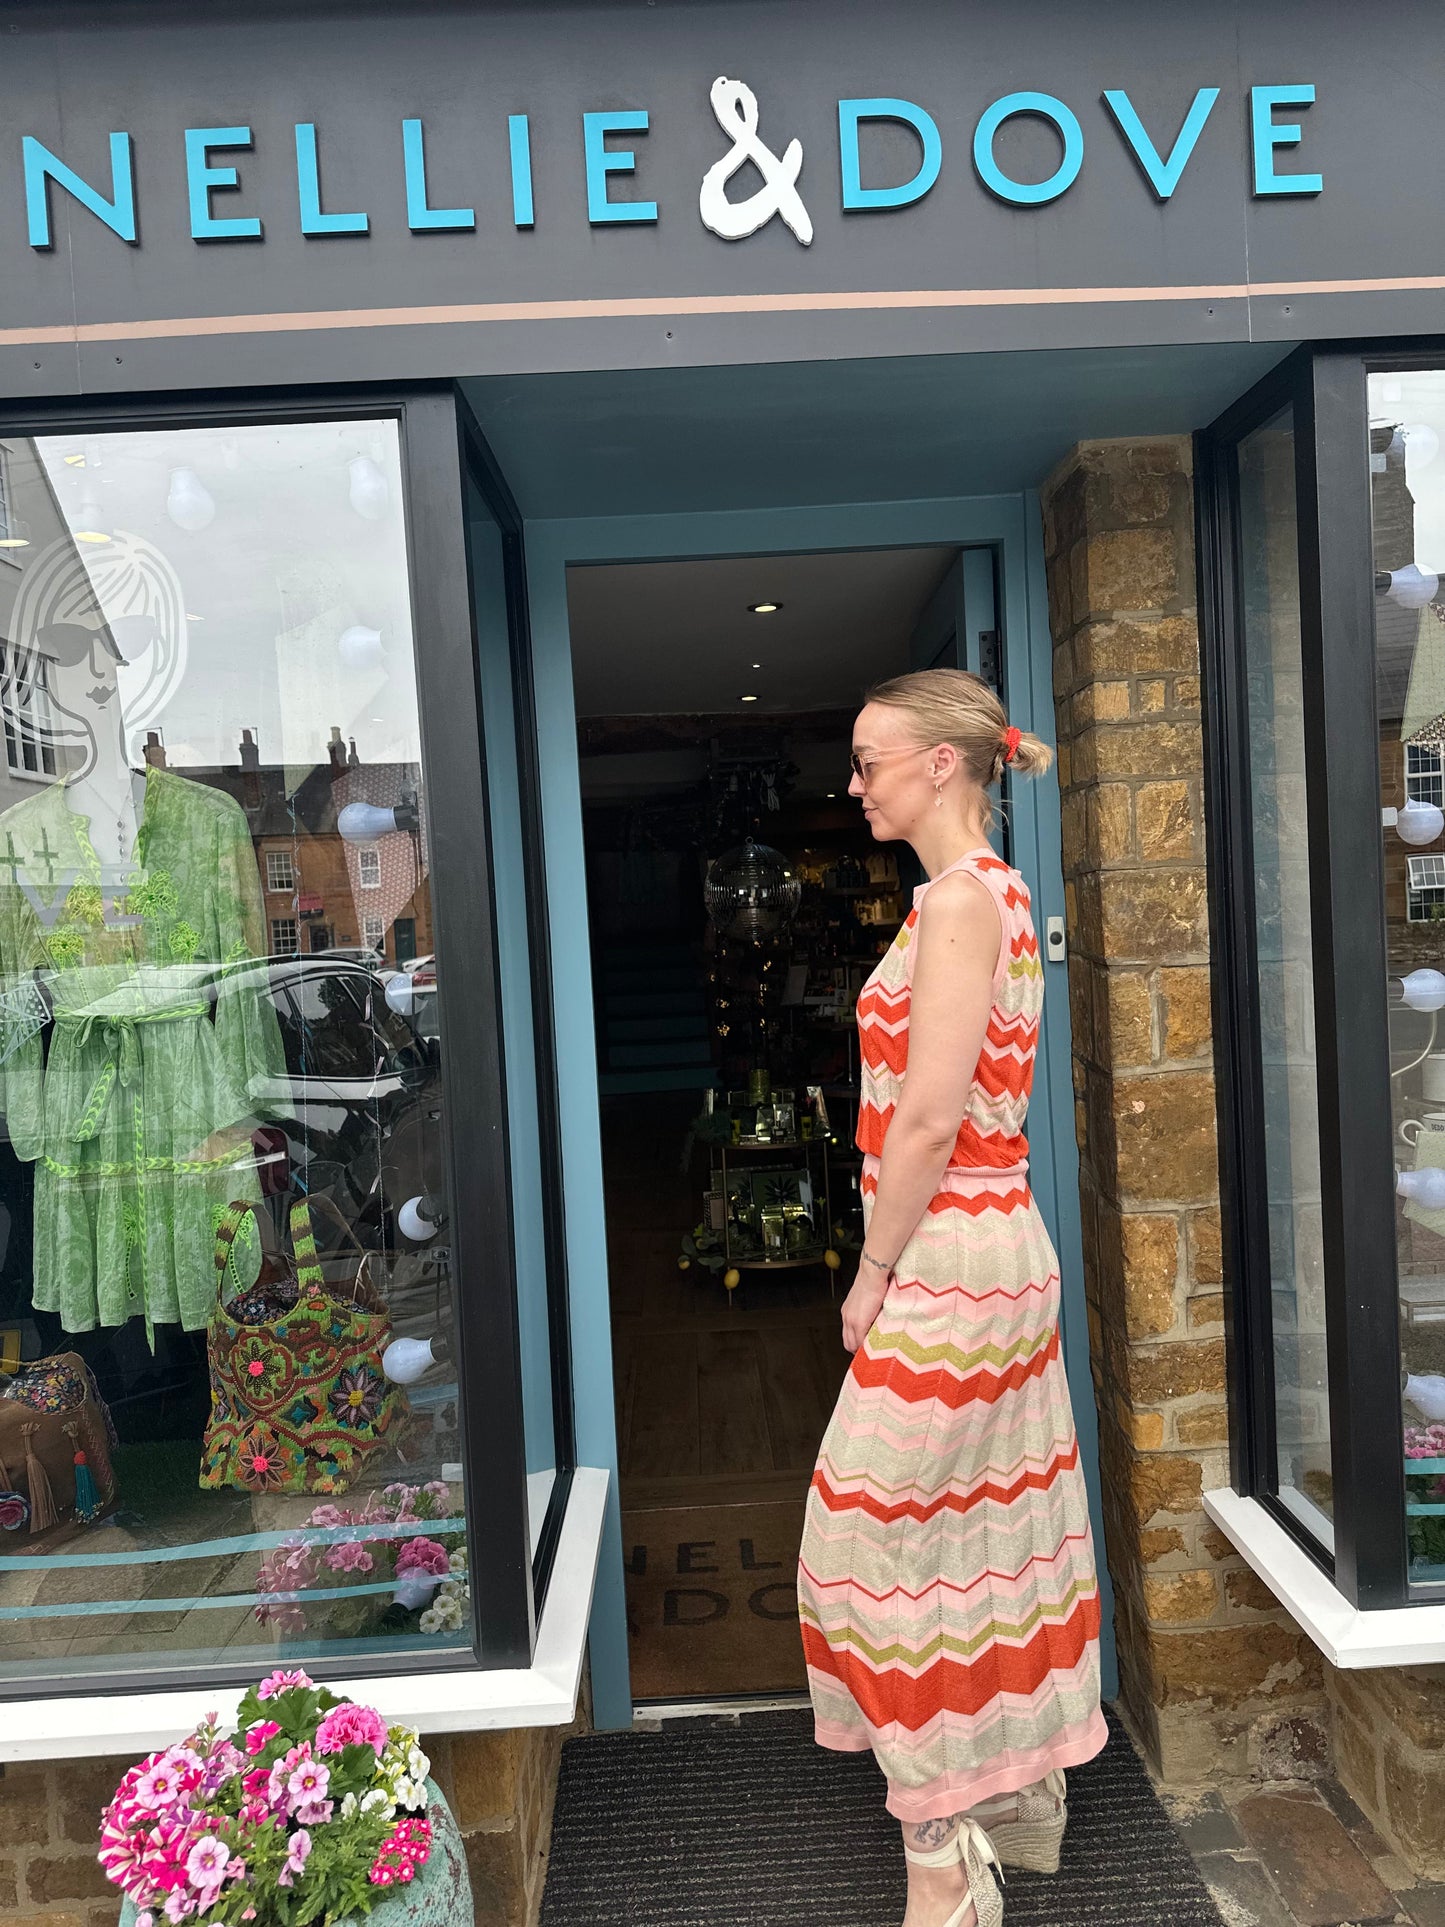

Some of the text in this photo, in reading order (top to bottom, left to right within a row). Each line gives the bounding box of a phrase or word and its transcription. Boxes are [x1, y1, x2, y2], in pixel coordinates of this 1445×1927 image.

[22, 75, 1324, 249] NELLIE & DOVE
